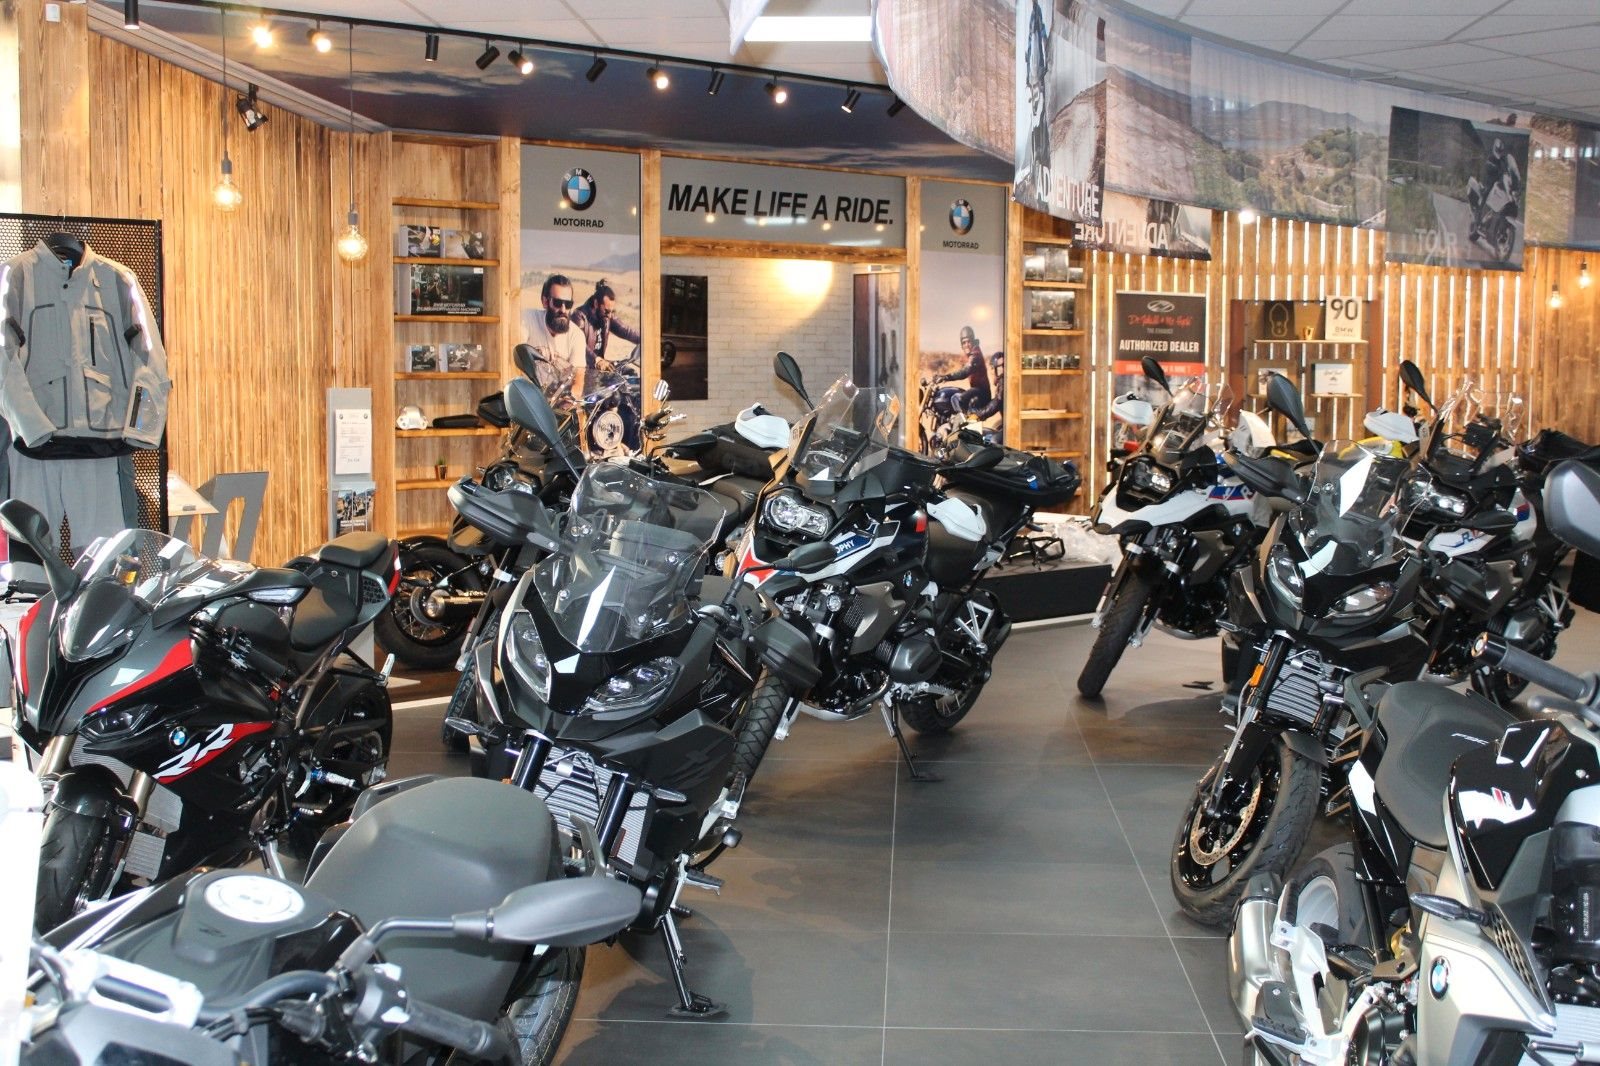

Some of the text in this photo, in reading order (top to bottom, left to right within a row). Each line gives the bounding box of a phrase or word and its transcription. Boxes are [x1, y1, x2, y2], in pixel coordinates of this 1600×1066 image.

[1036, 164, 1100, 218] ADVENTURE
[668, 184, 893, 224] MAKE LIFE A RIDE.
[553, 217, 604, 228] MOTORRAD
[942, 240, 979, 249] MOTORRAD
[1414, 228, 1458, 258] TOUR
[1331, 298, 1358, 320] 90
[1119, 339, 1200, 353] AUTHORIZED DEALER
[834, 539, 855, 554] OPHY
